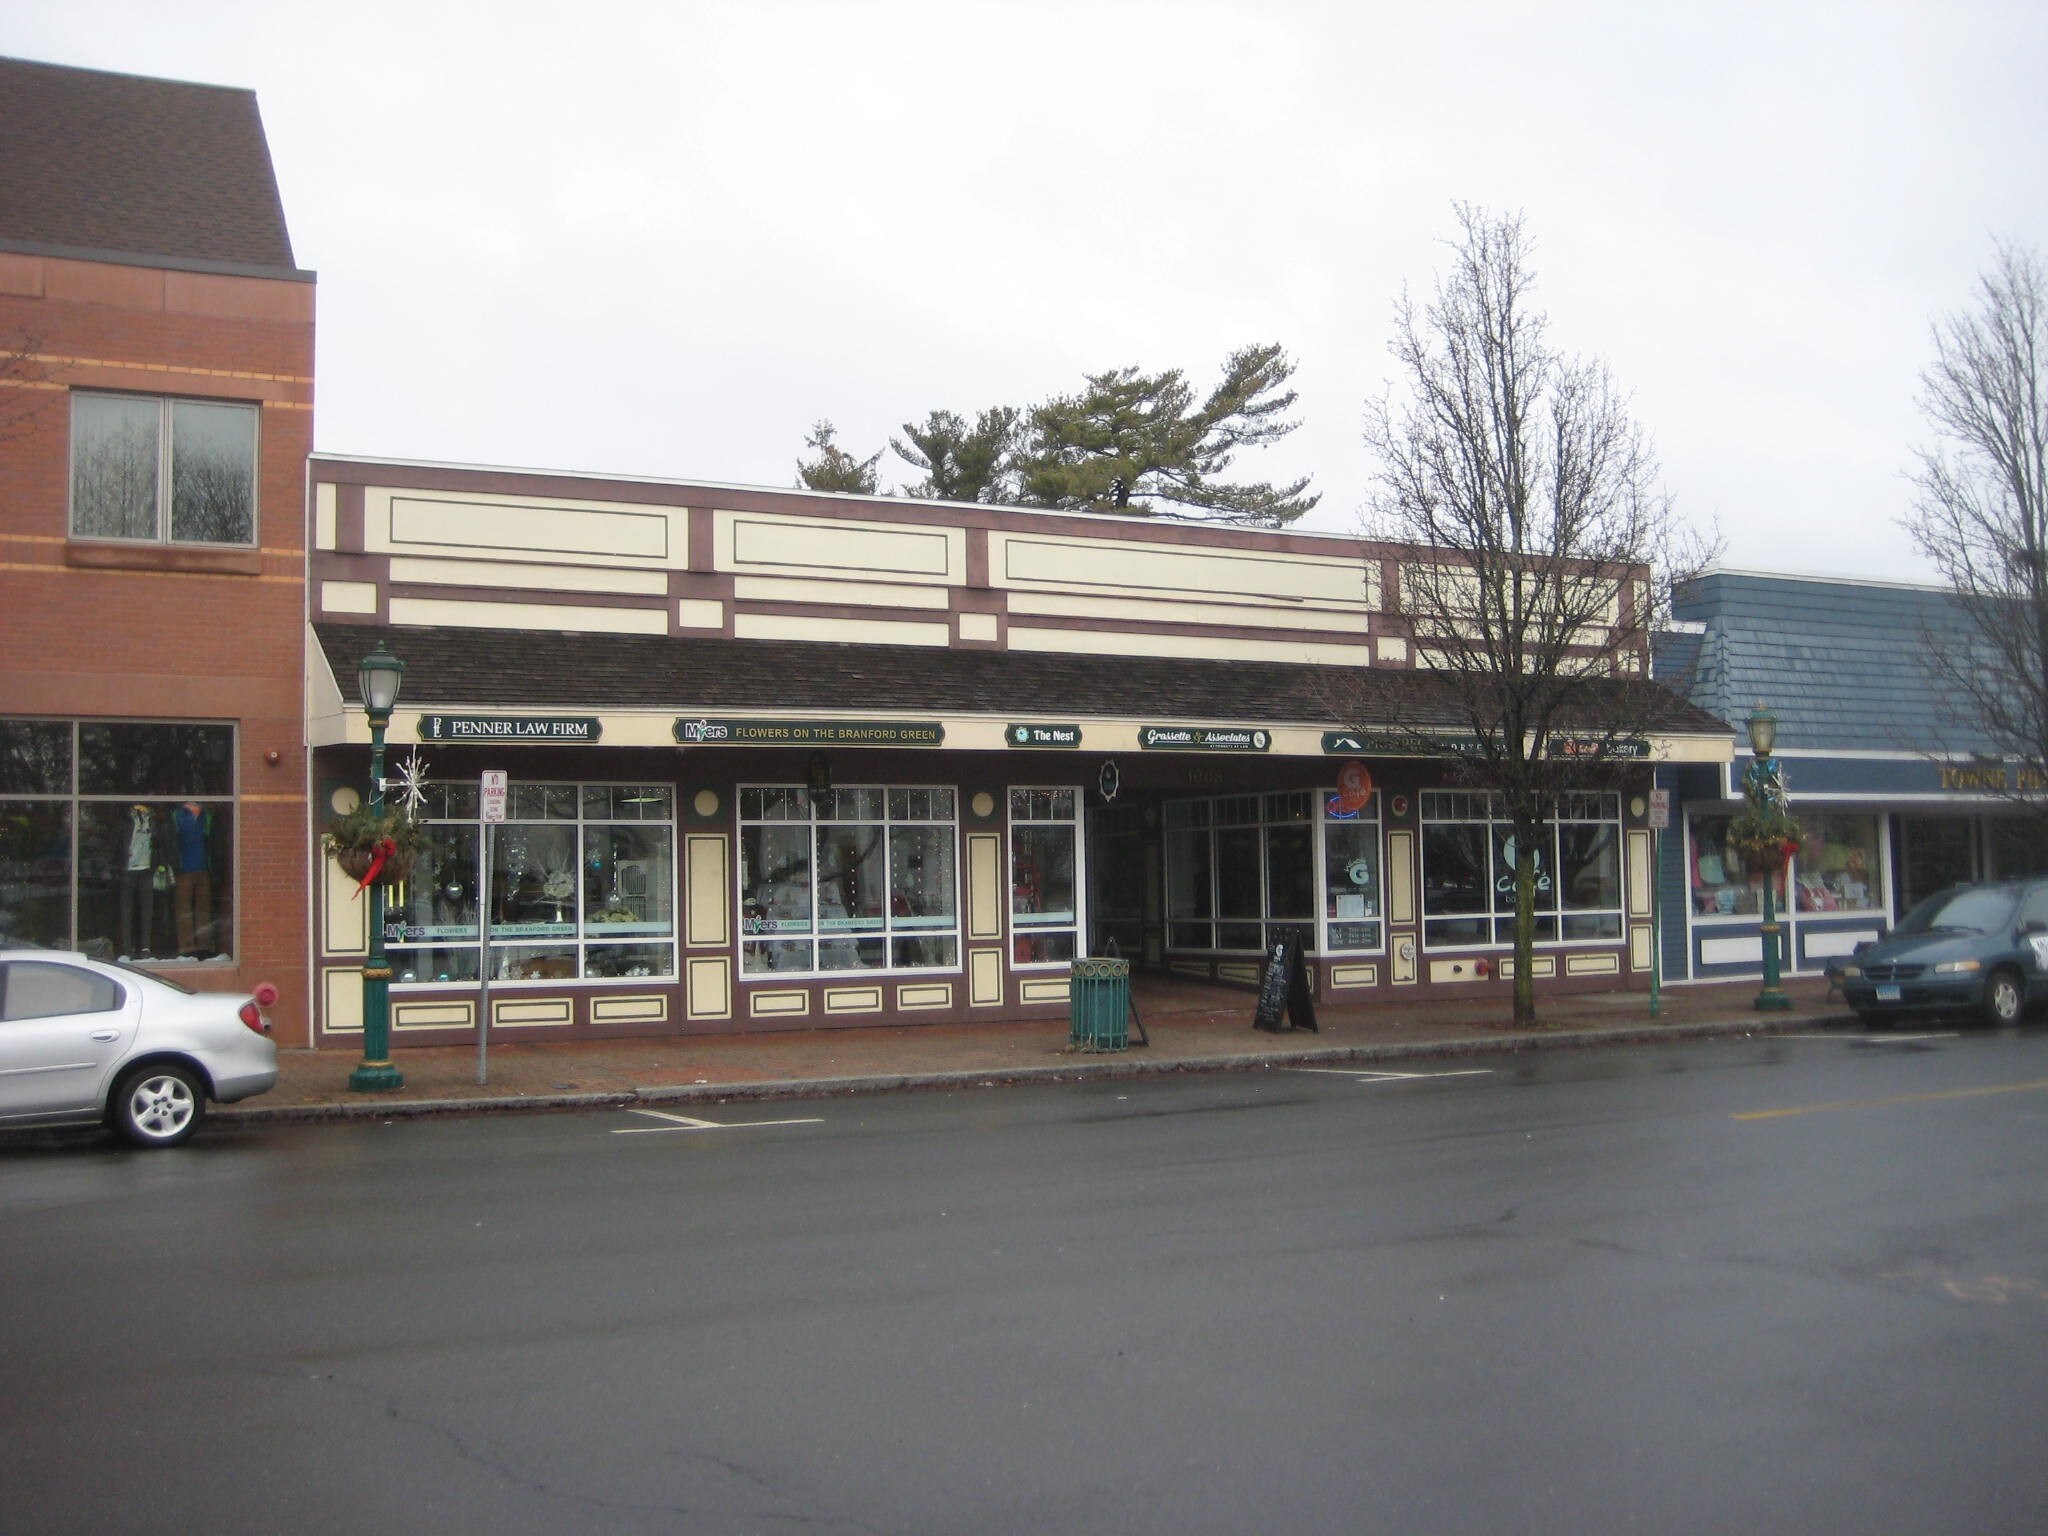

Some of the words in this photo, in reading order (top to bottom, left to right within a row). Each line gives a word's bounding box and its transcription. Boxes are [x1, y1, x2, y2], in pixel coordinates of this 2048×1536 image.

[452, 721, 513, 735] PENNER
[516, 722, 549, 735] LAW
[552, 722, 589, 736] FIRM
[685, 719, 728, 742] Myers
[735, 727, 789, 738] FLOWERS
[793, 728, 809, 738] ON
[814, 728, 834, 739] THE
[838, 729, 897, 739] BRANFORD
[900, 730, 936, 740] GREEN
[1033, 729, 1051, 740] The
[1053, 730, 1074, 741] Nest
[1147, 729, 1192, 744] Grassette
[1205, 732, 1250, 743] Associates
[491, 773, 499, 785] NO
[484, 787, 505, 797] PARKING
[386, 920, 426, 942] Myers
[744, 914, 778, 934] Myers
